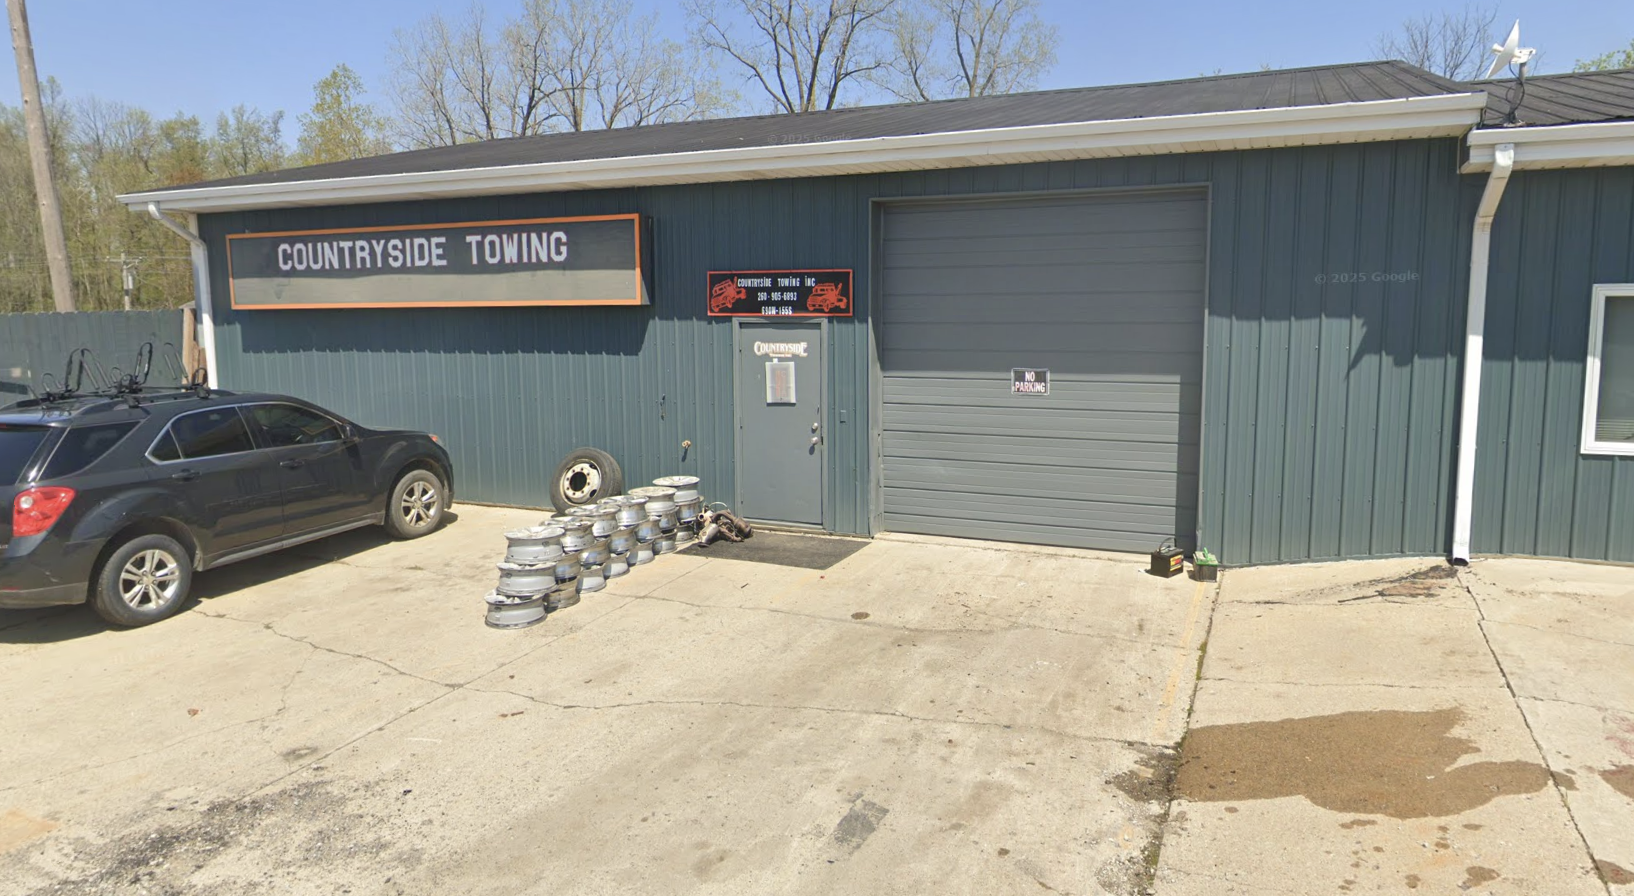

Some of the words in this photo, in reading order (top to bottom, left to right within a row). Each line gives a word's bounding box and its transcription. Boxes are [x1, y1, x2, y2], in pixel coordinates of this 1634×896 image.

[277, 237, 448, 270] COUNTRYSIDE
[465, 231, 568, 265] TOWING
[1025, 371, 1036, 382] NO
[1015, 381, 1046, 393] PARKING
